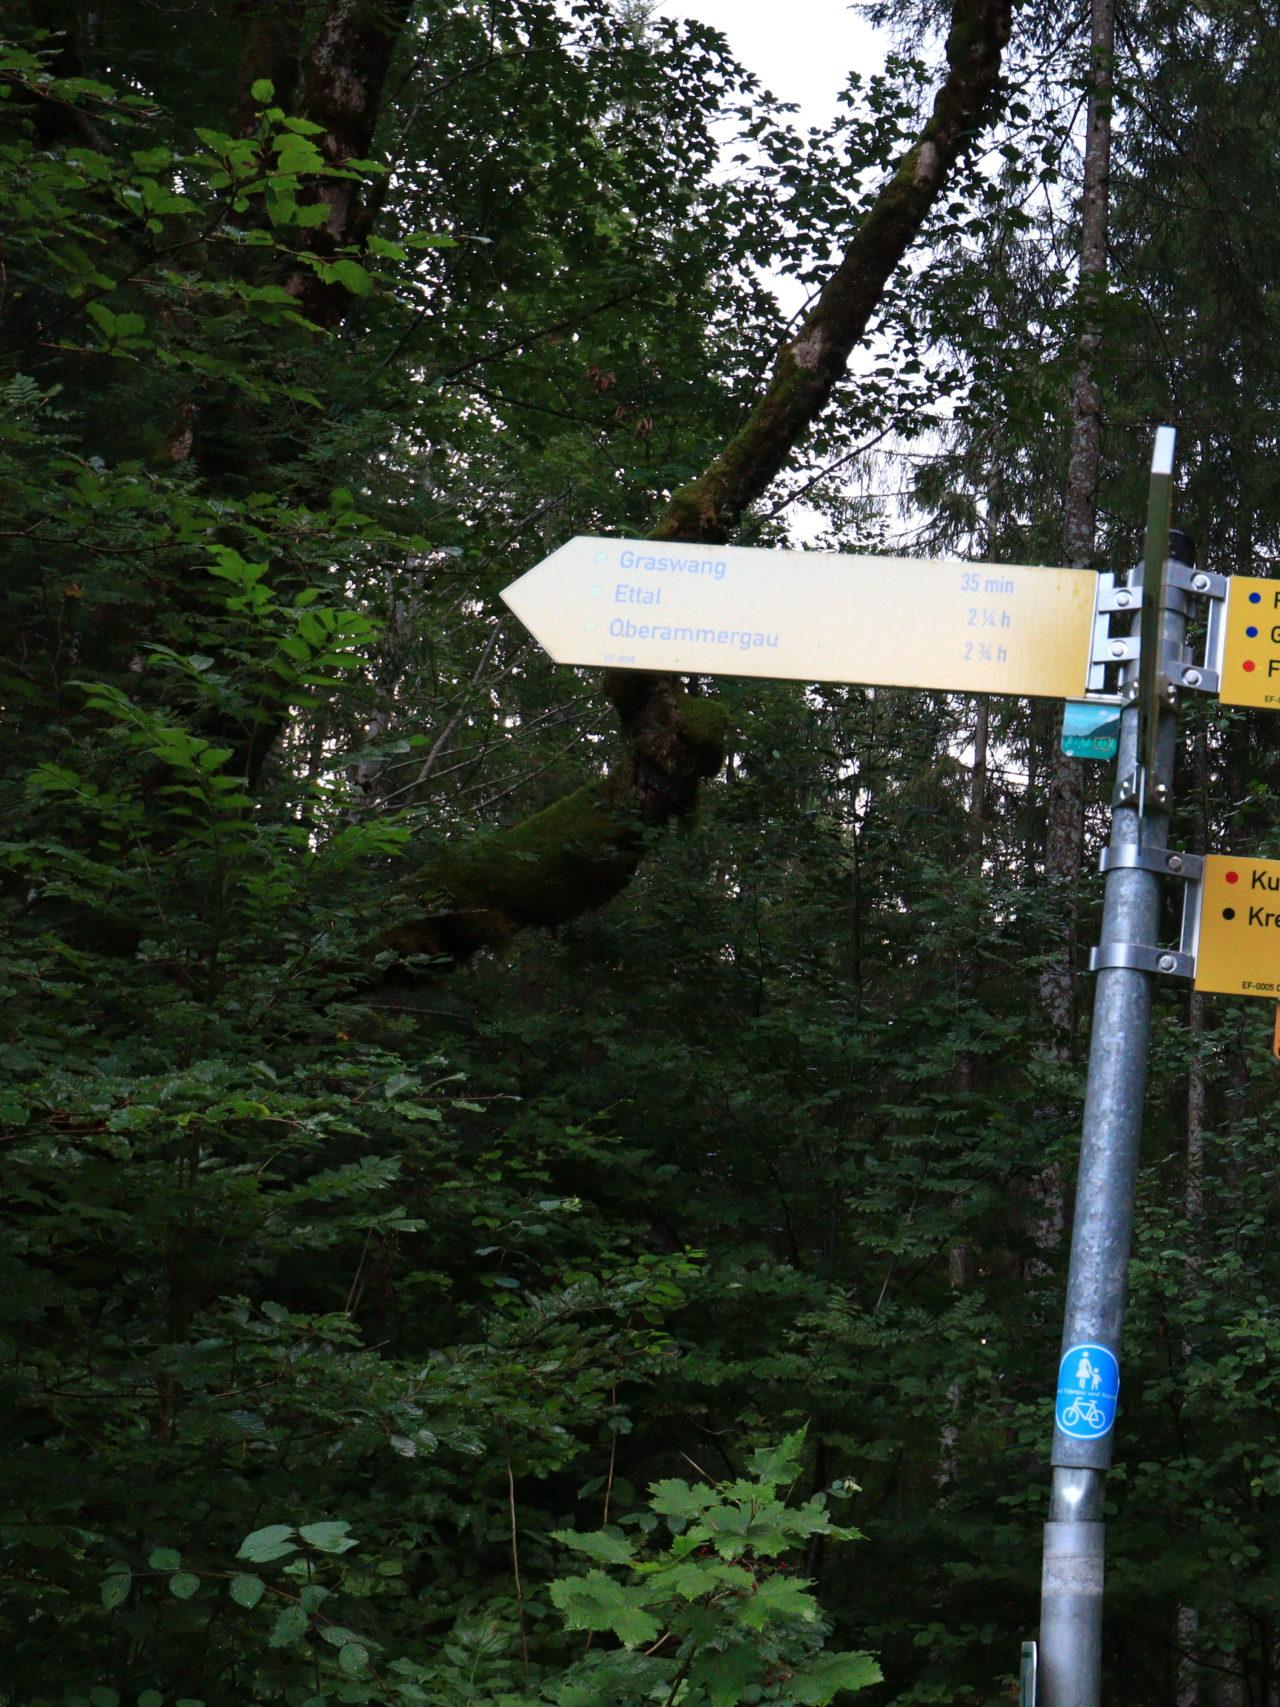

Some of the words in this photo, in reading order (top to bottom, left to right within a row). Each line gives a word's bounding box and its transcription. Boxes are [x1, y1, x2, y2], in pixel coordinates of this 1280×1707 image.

[620, 550, 727, 579] Graswang
[961, 574, 980, 592] 35
[984, 576, 1014, 594] min
[614, 584, 662, 605] Ettal
[967, 608, 976, 626] 2
[1002, 610, 1010, 628] h
[609, 618, 779, 650] Oberammergau
[964, 643, 973, 660] 2
[998, 645, 1007, 662] h
[1242, 981, 1274, 992] EF-0005
